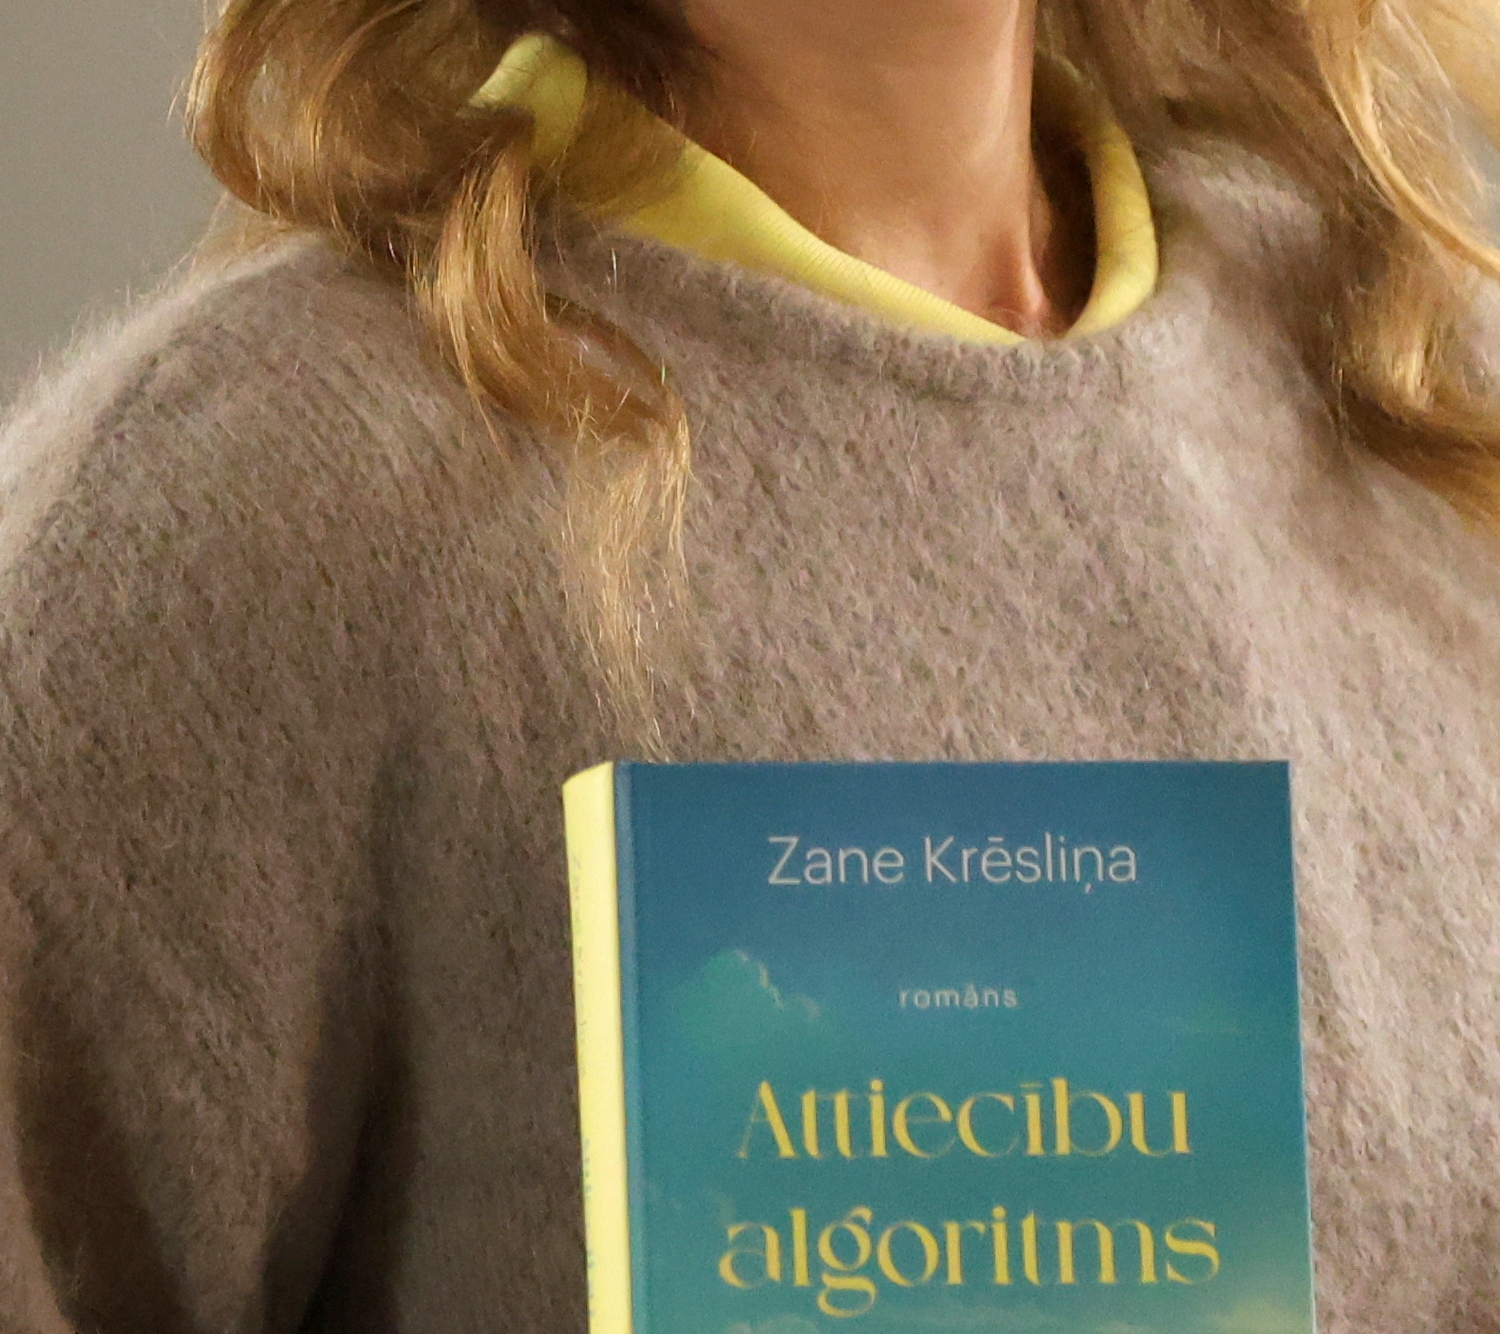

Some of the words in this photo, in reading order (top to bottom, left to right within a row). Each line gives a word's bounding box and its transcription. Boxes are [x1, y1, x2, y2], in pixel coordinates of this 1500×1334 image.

[768, 836, 904, 886] Zane
[923, 833, 1139, 893] Krēsliņa
[899, 984, 1020, 1009] romāns
[735, 1077, 1193, 1160] Attiecību
[717, 1205, 1222, 1319] algoritms
